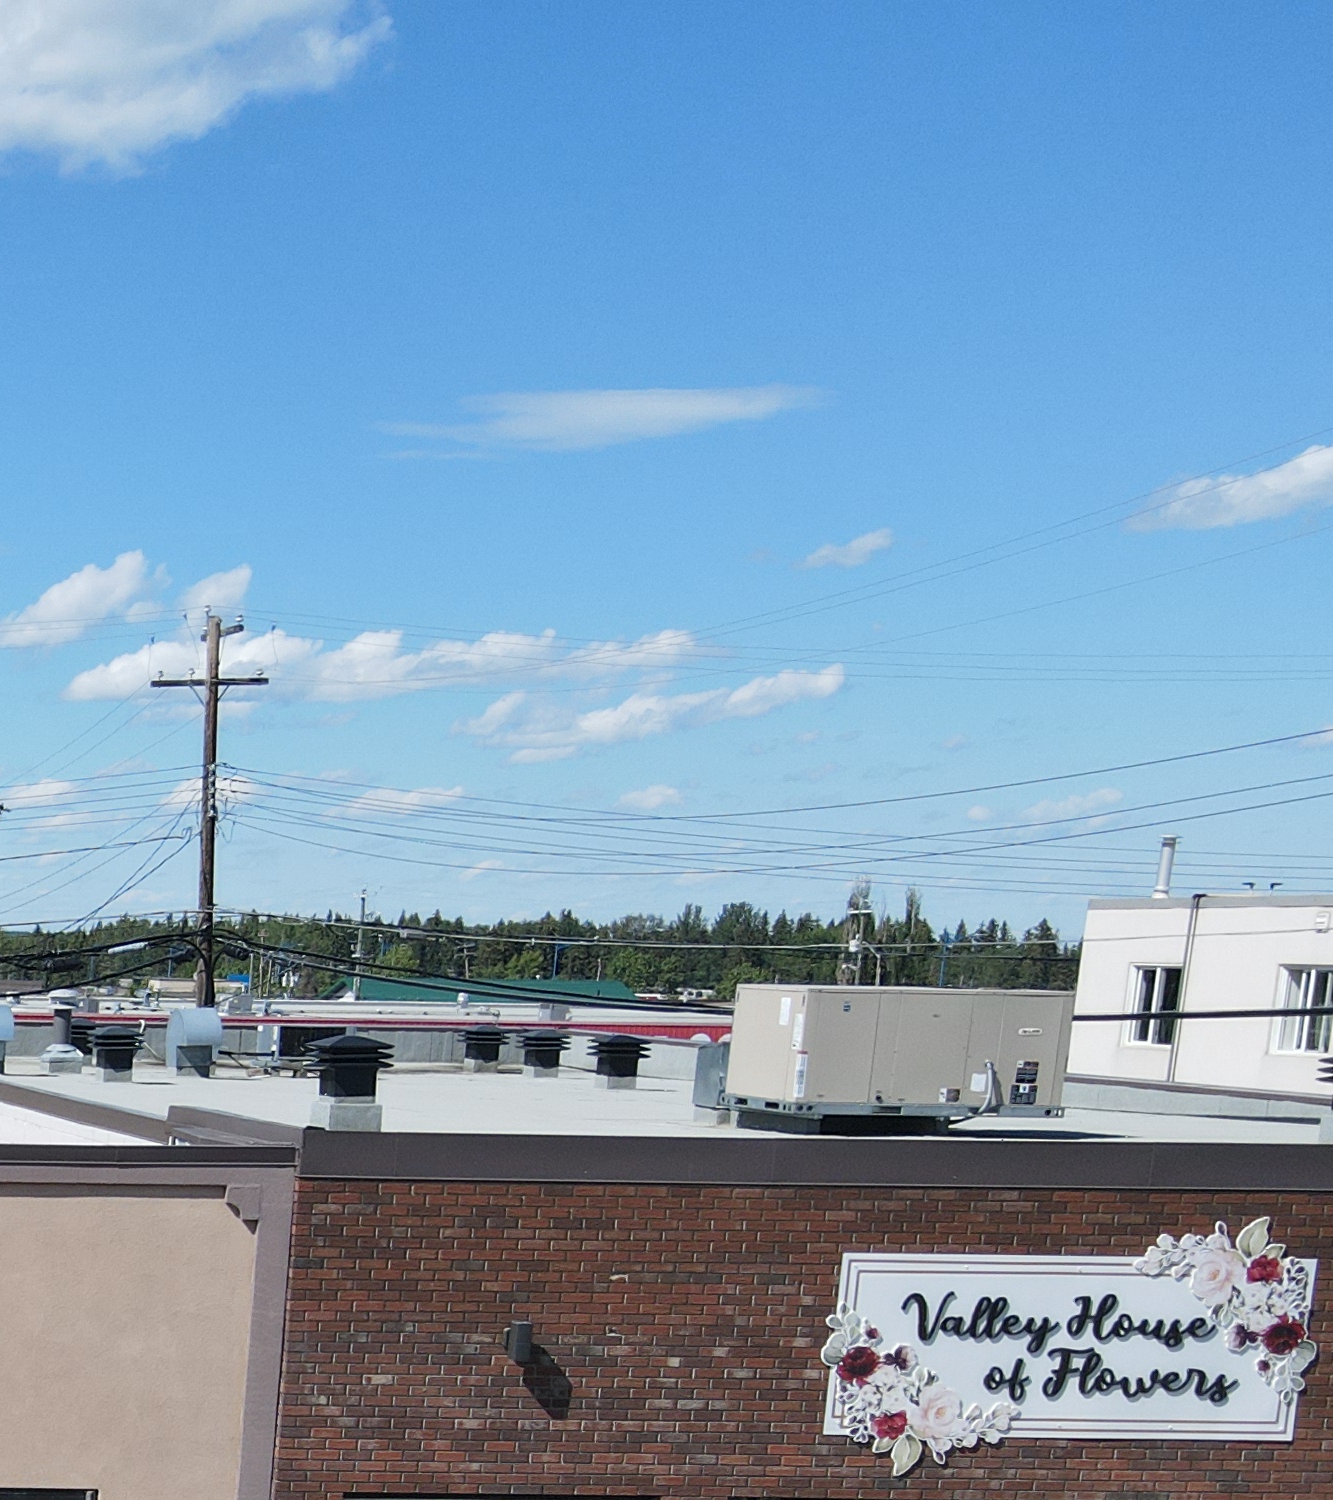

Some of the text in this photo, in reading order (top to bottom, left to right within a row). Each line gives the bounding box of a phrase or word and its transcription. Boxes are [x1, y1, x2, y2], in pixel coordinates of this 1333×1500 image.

[901, 1289, 1216, 1354] Valley House
[983, 1346, 1240, 1402] of Flowers
